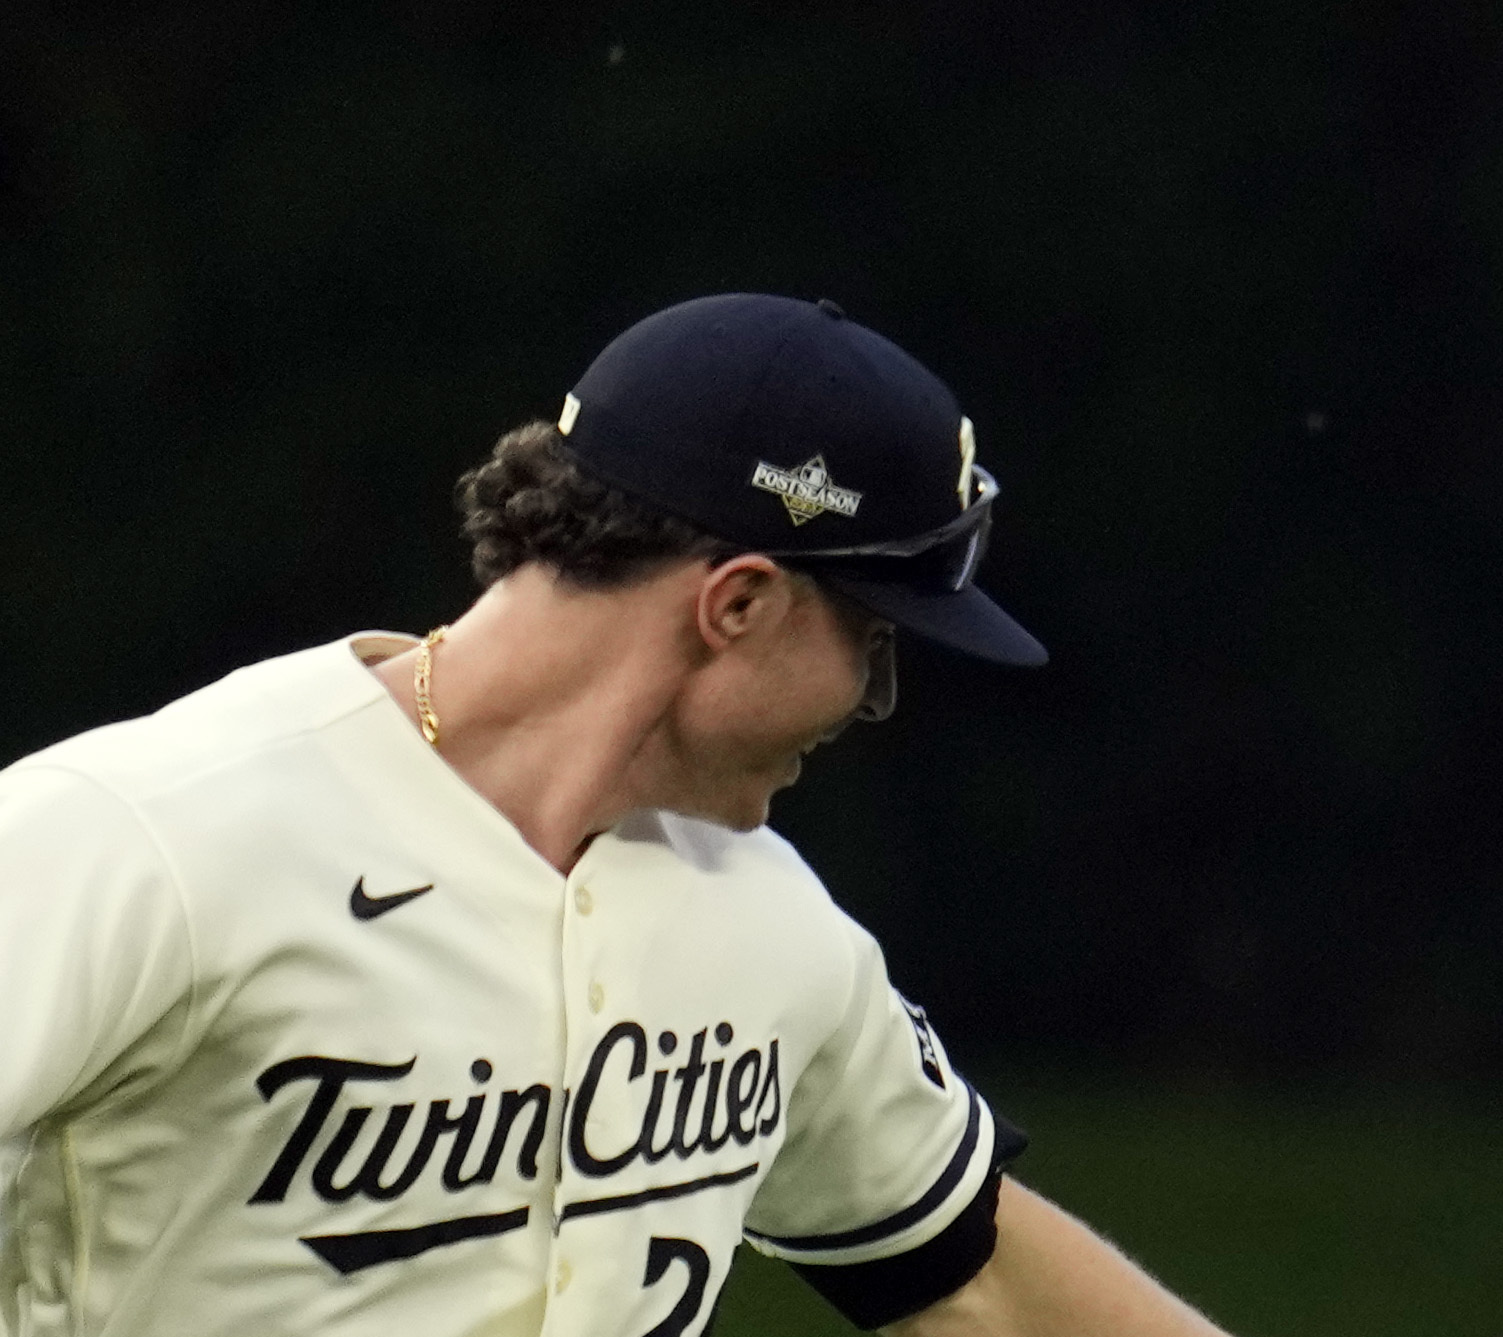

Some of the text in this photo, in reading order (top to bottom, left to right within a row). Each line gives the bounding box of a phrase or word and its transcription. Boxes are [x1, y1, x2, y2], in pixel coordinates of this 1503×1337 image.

[752, 464, 860, 516] POSTSEASON
[247, 1053, 562, 1205] Twin
[565, 1021, 781, 1179] Cities
